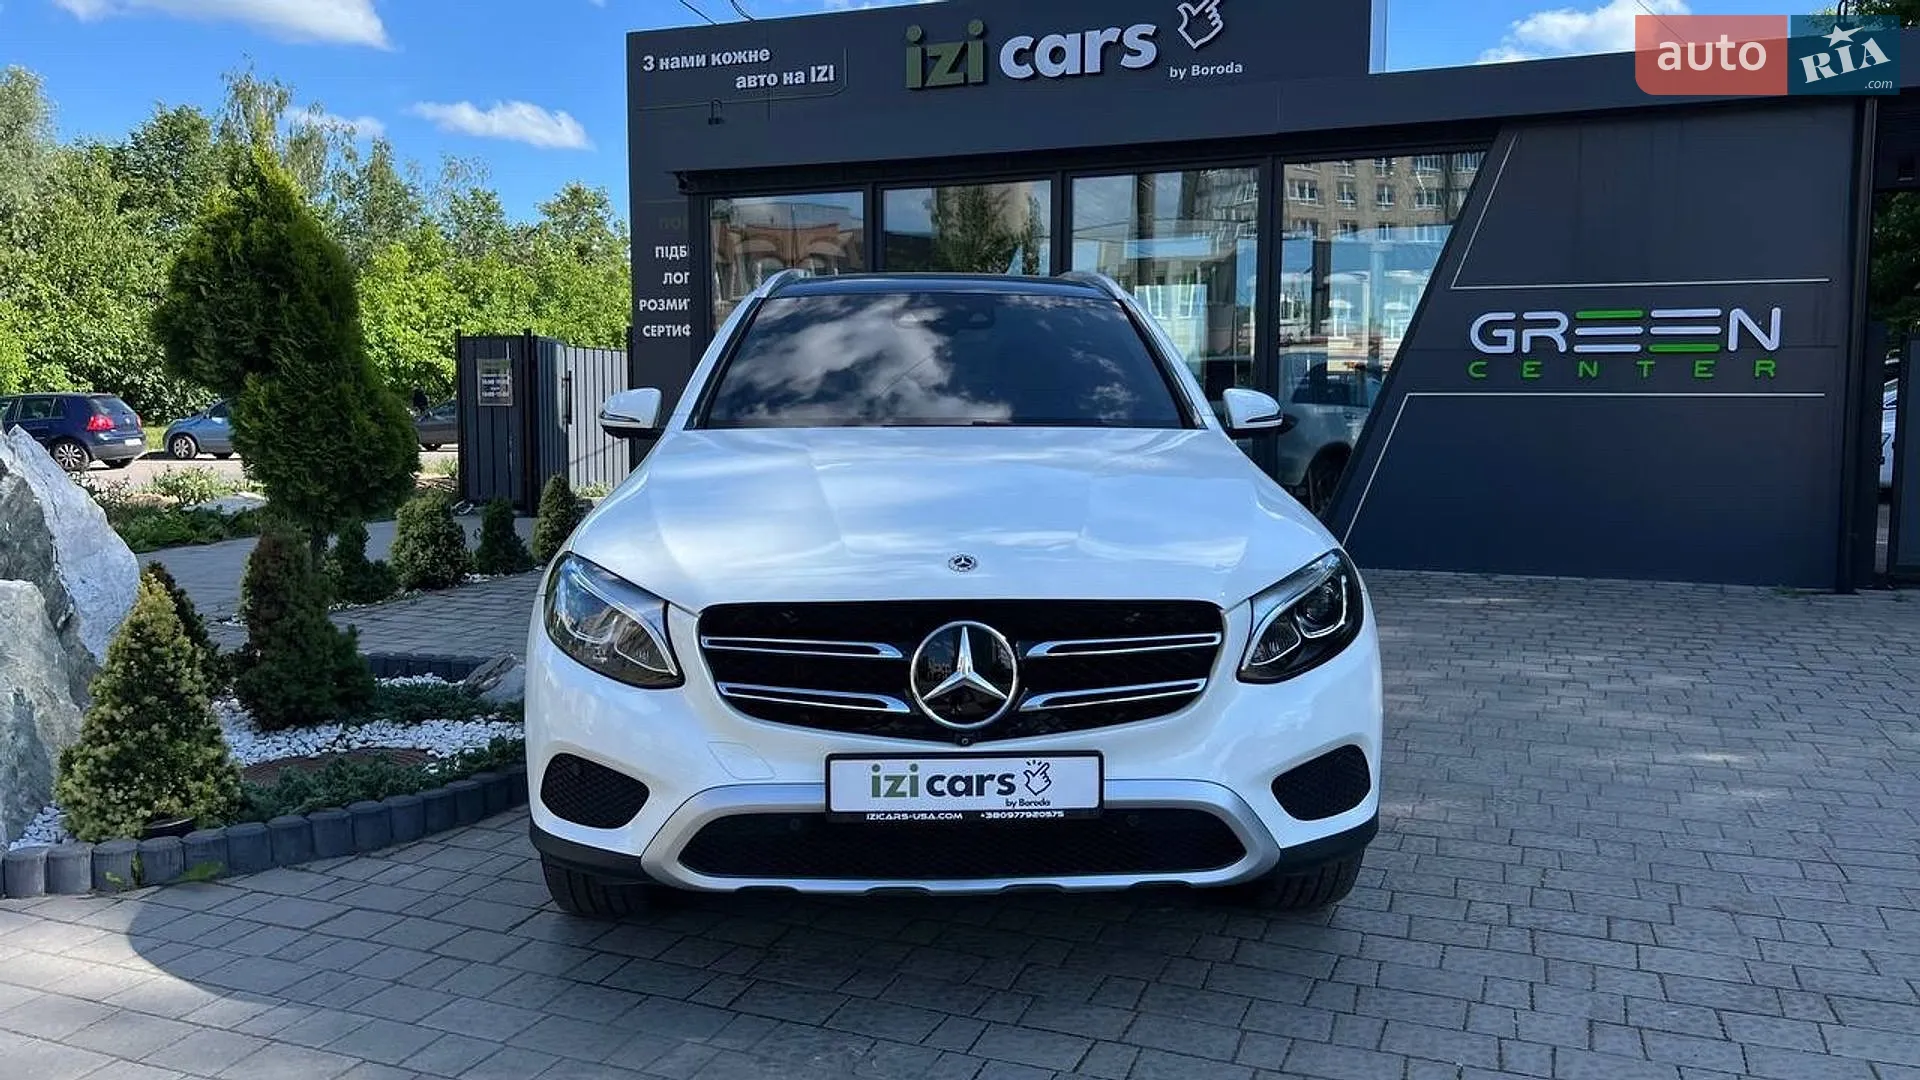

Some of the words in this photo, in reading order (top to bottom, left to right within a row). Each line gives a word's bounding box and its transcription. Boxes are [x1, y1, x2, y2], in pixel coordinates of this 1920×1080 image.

[659, 53, 707, 71] нами
[710, 48, 771, 67] кожне
[905, 19, 984, 89] izi
[1000, 24, 1157, 79] cars
[735, 73, 778, 90] авто
[782, 70, 806, 86] на
[810, 65, 835, 83] IZI
[1169, 66, 1187, 79] by
[1191, 62, 1243, 77] Boroda
[655, 245, 689, 261] ПІДБ
[1470, 307, 1782, 353] GREEN
[1467, 360, 1777, 379] CENTER
[871, 763, 919, 798] izi
[926, 773, 1017, 798] cars
[1005, 799, 1017, 808] by
[1018, 798, 1051, 807] Boroda
[865, 812, 964, 821] IZICARS-USA.COM
